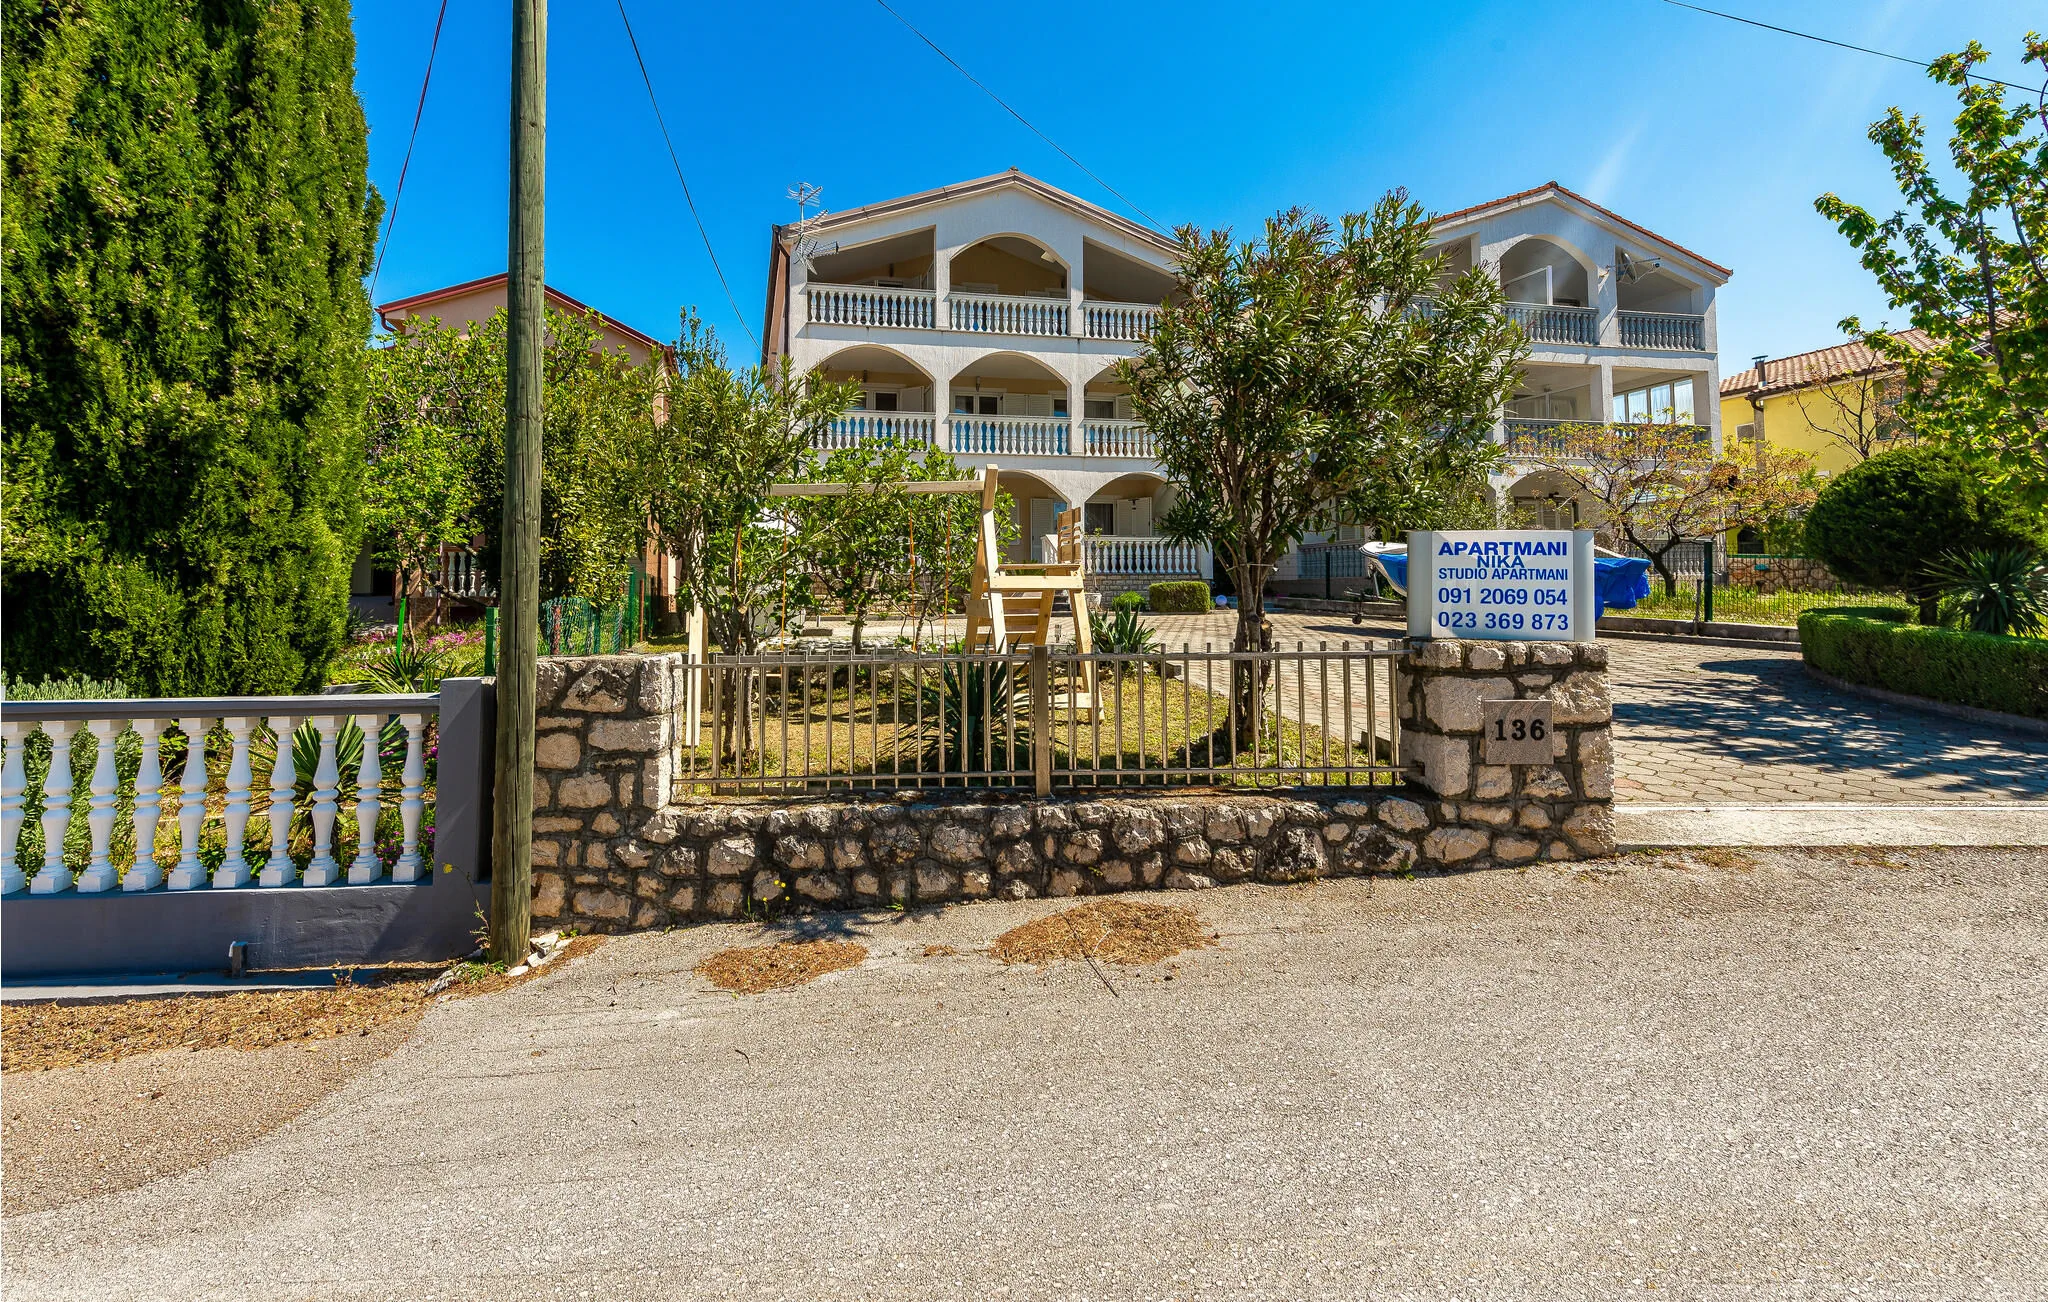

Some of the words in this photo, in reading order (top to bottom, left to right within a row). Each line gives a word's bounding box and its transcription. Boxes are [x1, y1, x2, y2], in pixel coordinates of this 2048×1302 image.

[1438, 541, 1567, 556] APARTMANI
[1477, 555, 1525, 568] NIKA
[1438, 568, 1488, 580] STUDIO
[1491, 568, 1568, 581] APARTMANI
[1438, 588, 1471, 604] 091
[1480, 588, 1528, 605] 2069
[1533, 589, 1568, 605] 054
[1438, 612, 1477, 628] 023
[1485, 613, 1524, 630] 369
[1531, 614, 1569, 631] 873
[1495, 719, 1545, 741] 136
